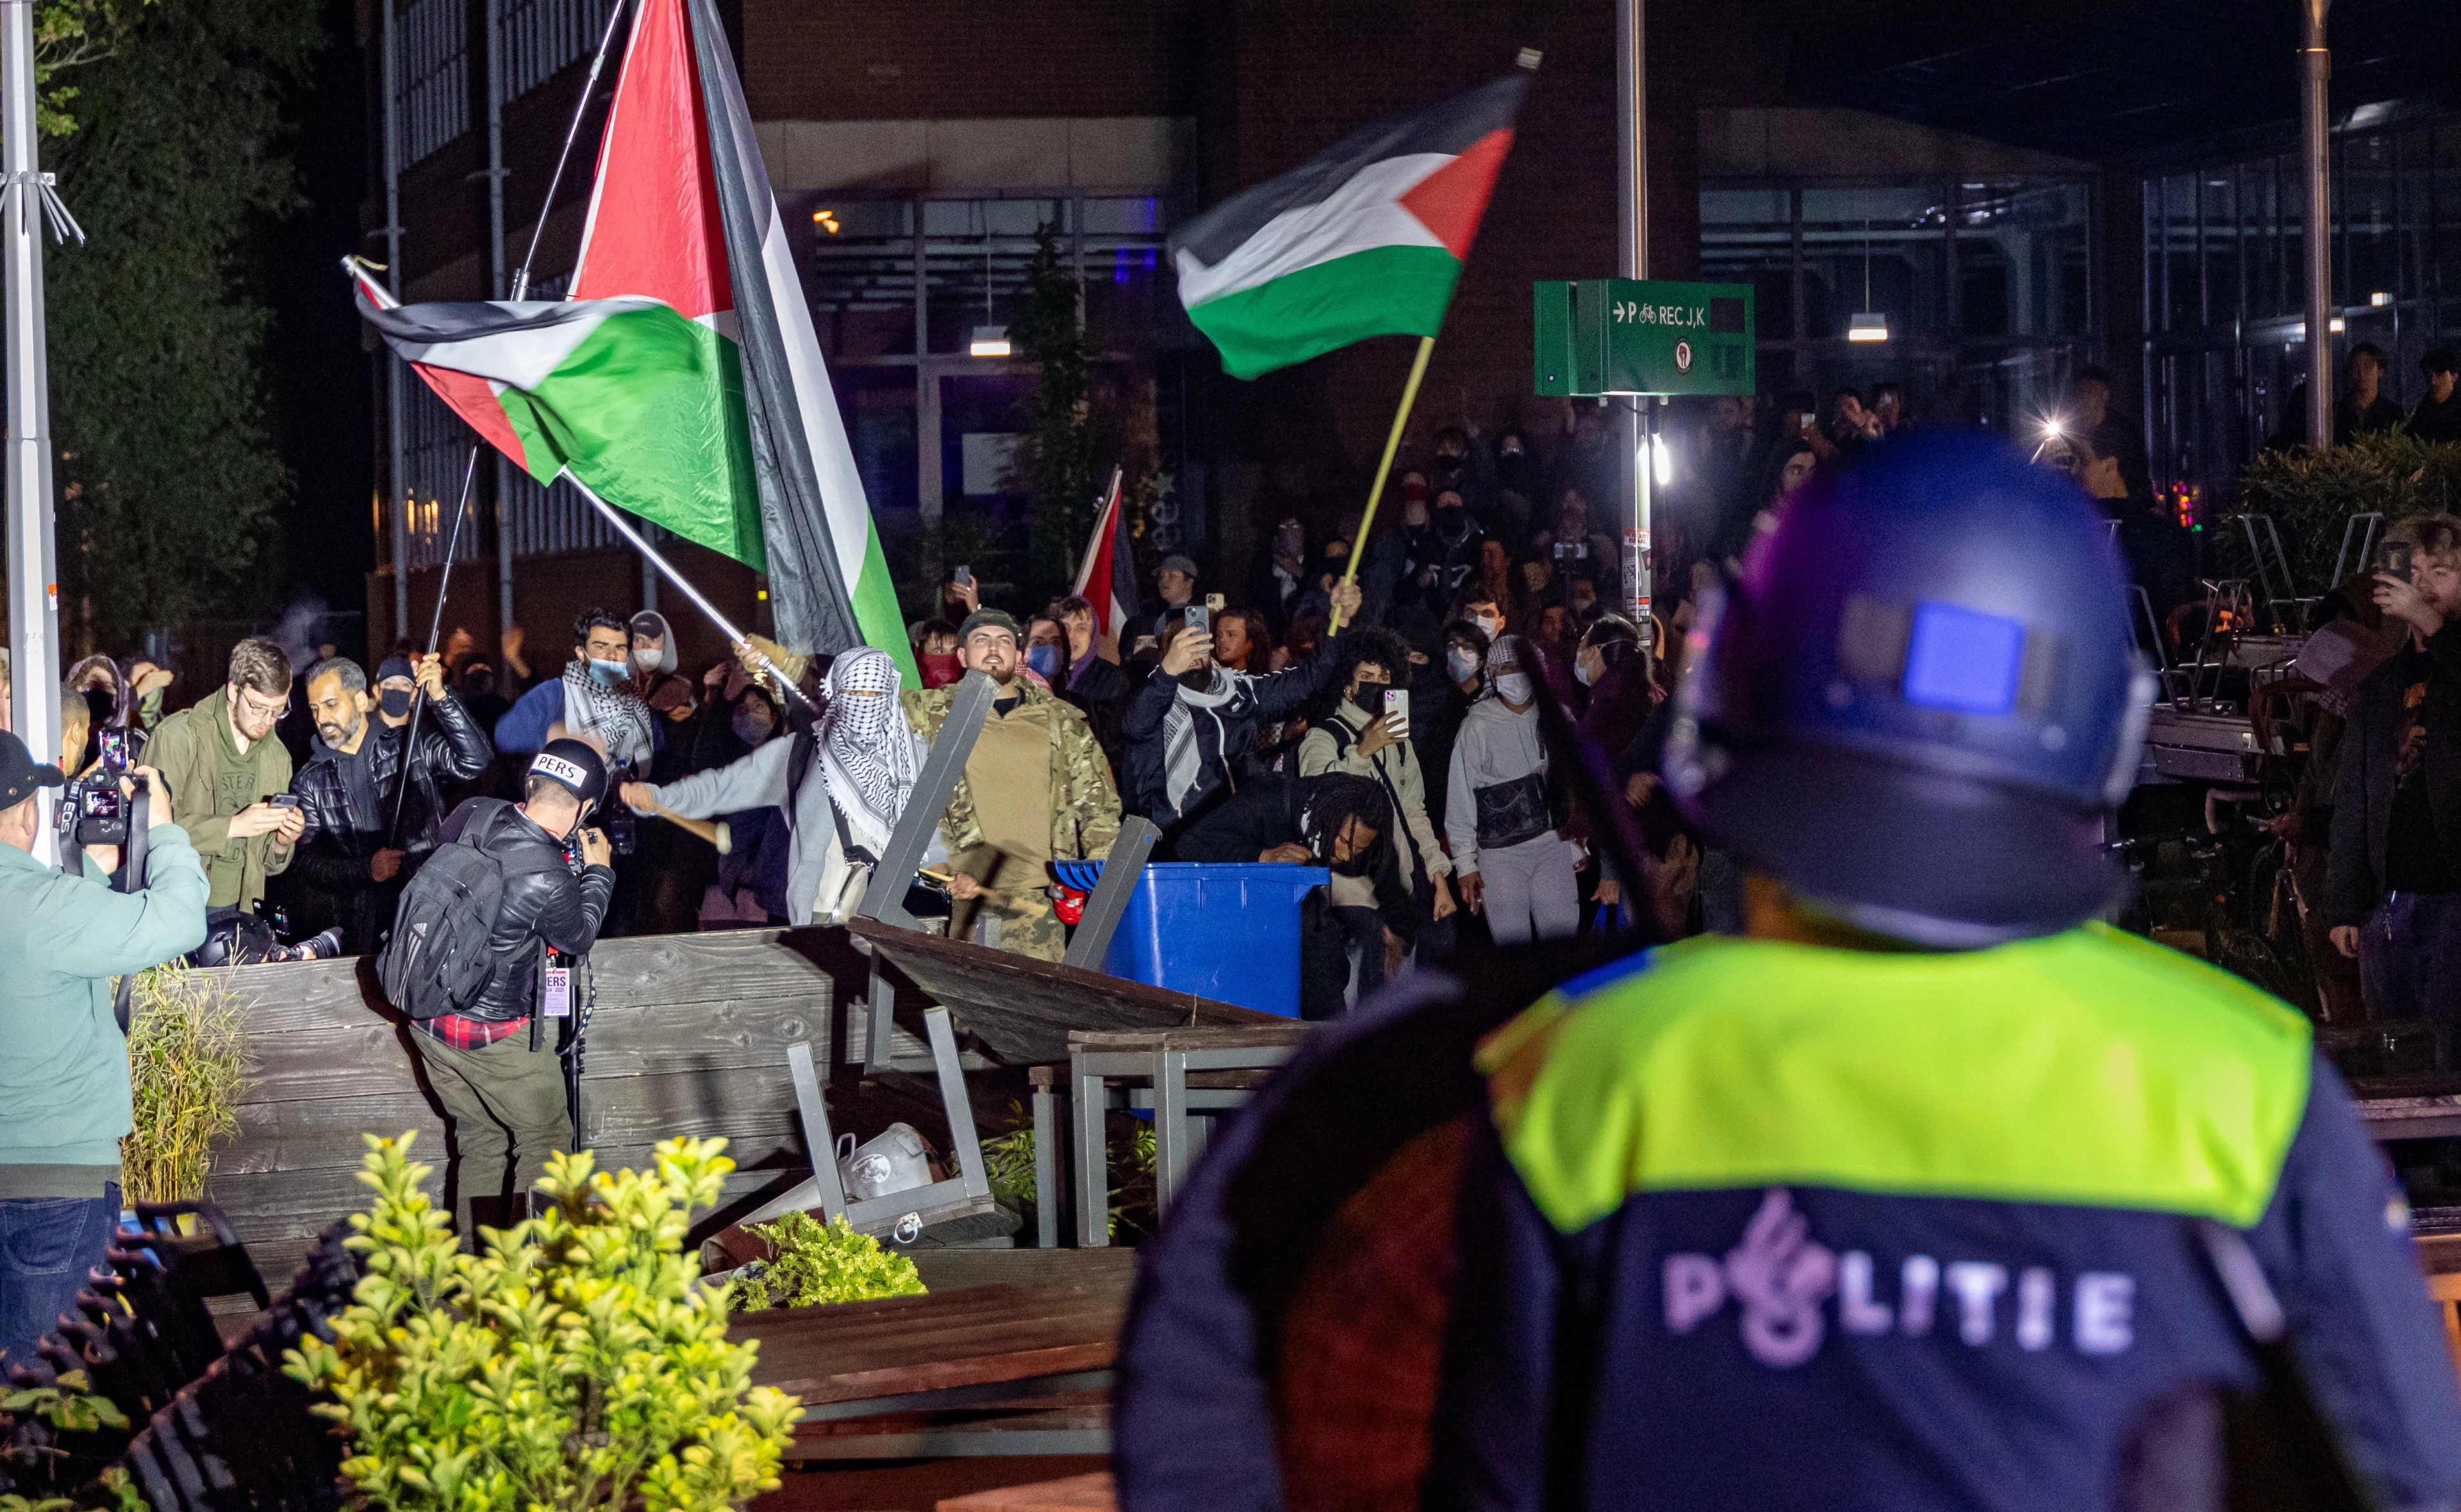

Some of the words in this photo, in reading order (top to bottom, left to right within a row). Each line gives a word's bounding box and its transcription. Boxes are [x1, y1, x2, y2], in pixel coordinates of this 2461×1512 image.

[1628, 301, 1637, 324] P
[1659, 306, 1684, 325] REC
[538, 757, 577, 778] PERS
[60, 801, 76, 834] EOS
[547, 976, 567, 987] ERS
